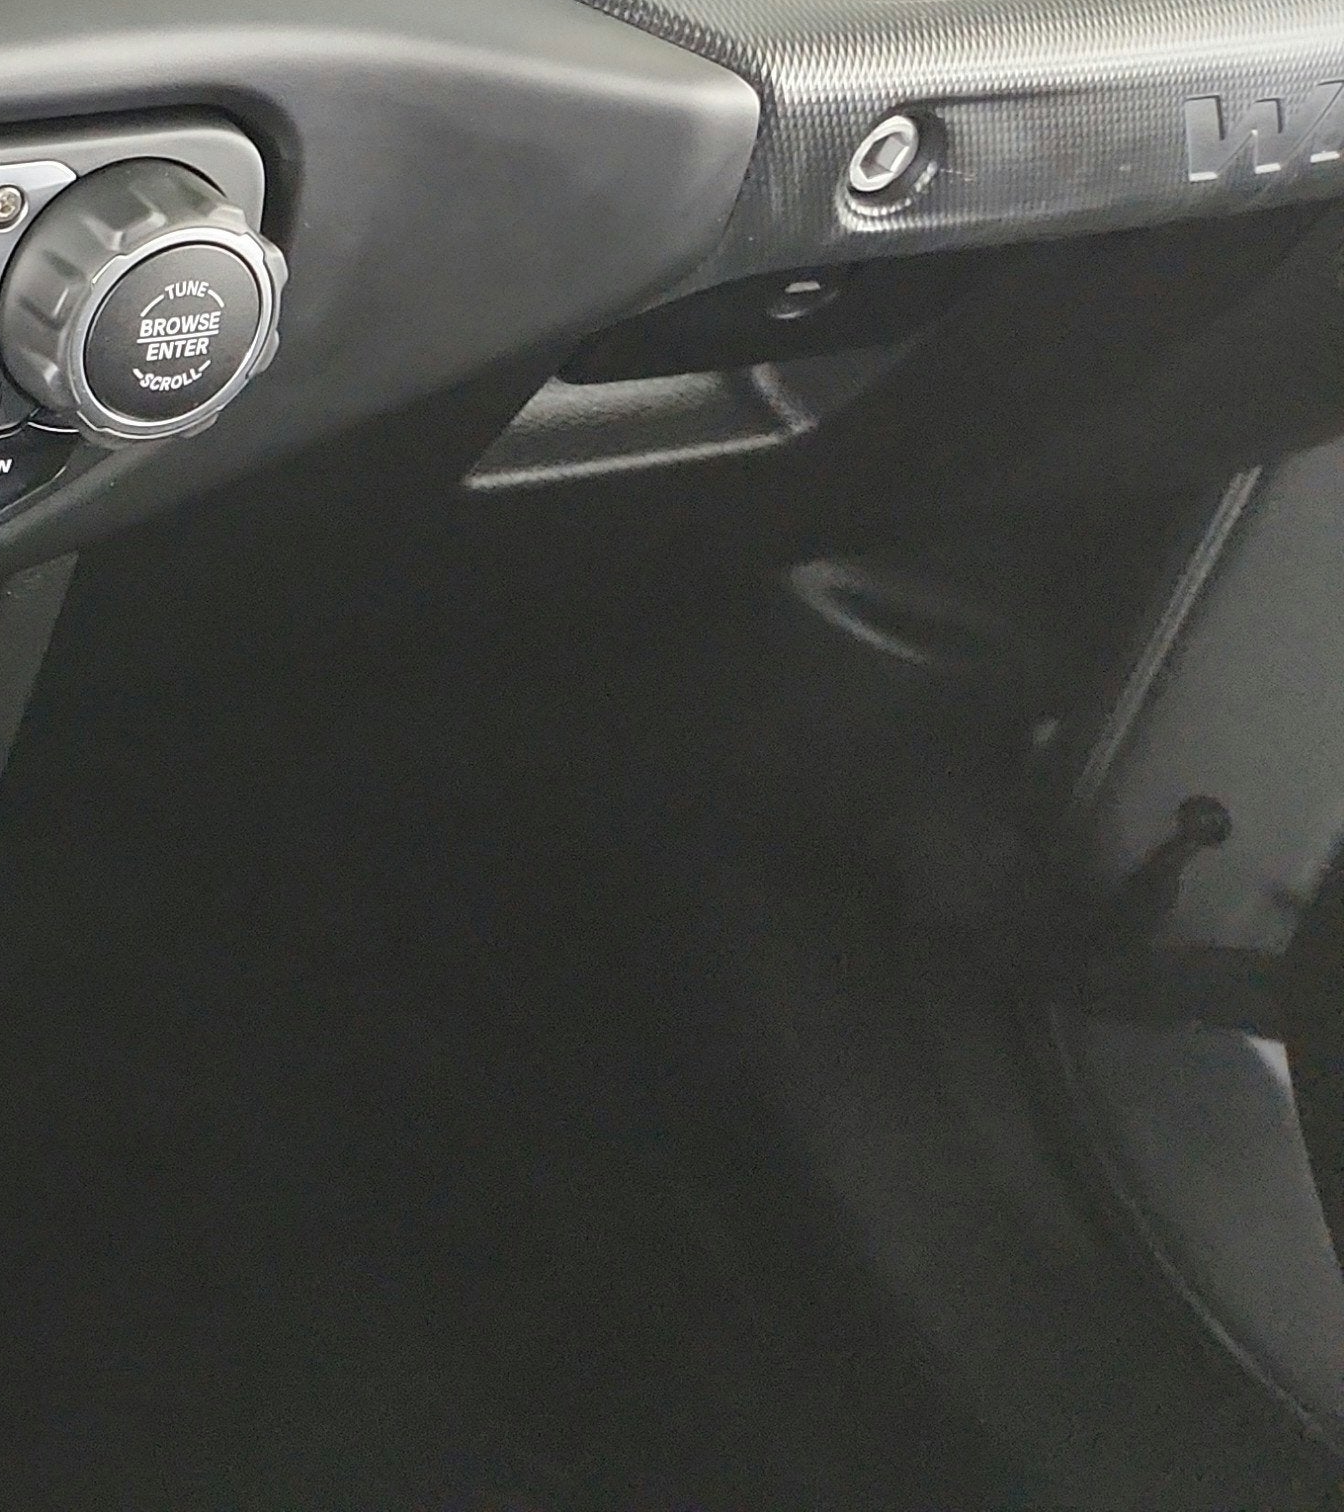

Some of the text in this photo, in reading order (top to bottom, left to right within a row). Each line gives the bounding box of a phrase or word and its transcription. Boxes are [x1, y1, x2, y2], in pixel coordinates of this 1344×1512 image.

[164, 279, 210, 301] TUNE
[139, 310, 222, 337] BROWSE
[145, 337, 210, 362] ENTER
[139, 367, 203, 392] SCROLL
